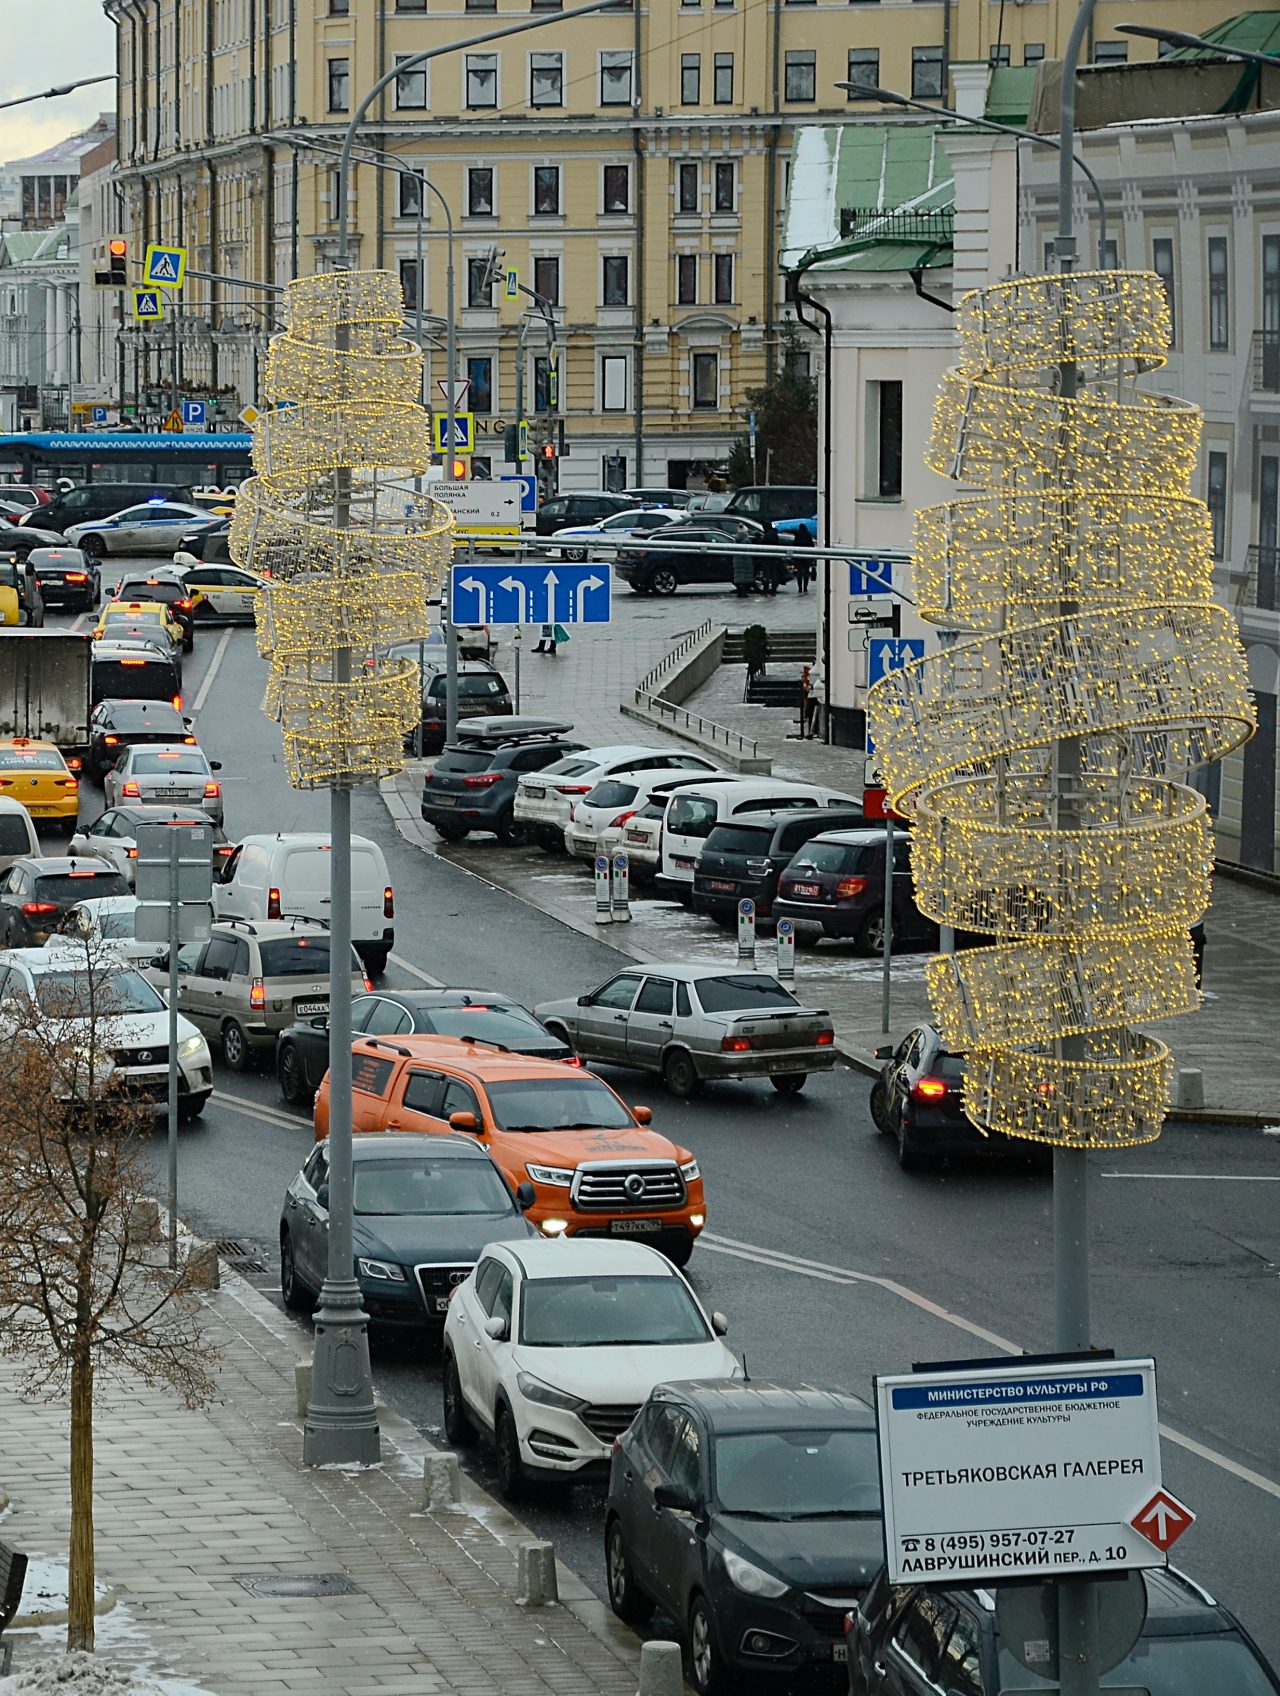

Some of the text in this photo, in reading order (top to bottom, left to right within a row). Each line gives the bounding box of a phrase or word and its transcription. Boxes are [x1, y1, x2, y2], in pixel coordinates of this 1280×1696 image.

[928, 1380, 1108, 1402] МИНИСТЕРСТВО КУЛЬТУРЫ РФ
[916, 1401, 1120, 1421] ФЕДЕРАЛЬНОЕ ГОСУДАРСТВЕННОЕ БЮДЖЕТНОЕ
[967, 1413, 1071, 1428] УЧРЕЖДЕНИЕ КУЛЬТУРЫ
[902, 1458, 1144, 1487] ТРЕТЬЯКОВСКАЯ ГАЛЕРЕЯ
[924, 1530, 1075, 1554] 8 (495) 957-07-27
[902, 1546, 1127, 1573] ЛАВРУШИНСКИЙ ПЕР., Д. 10
